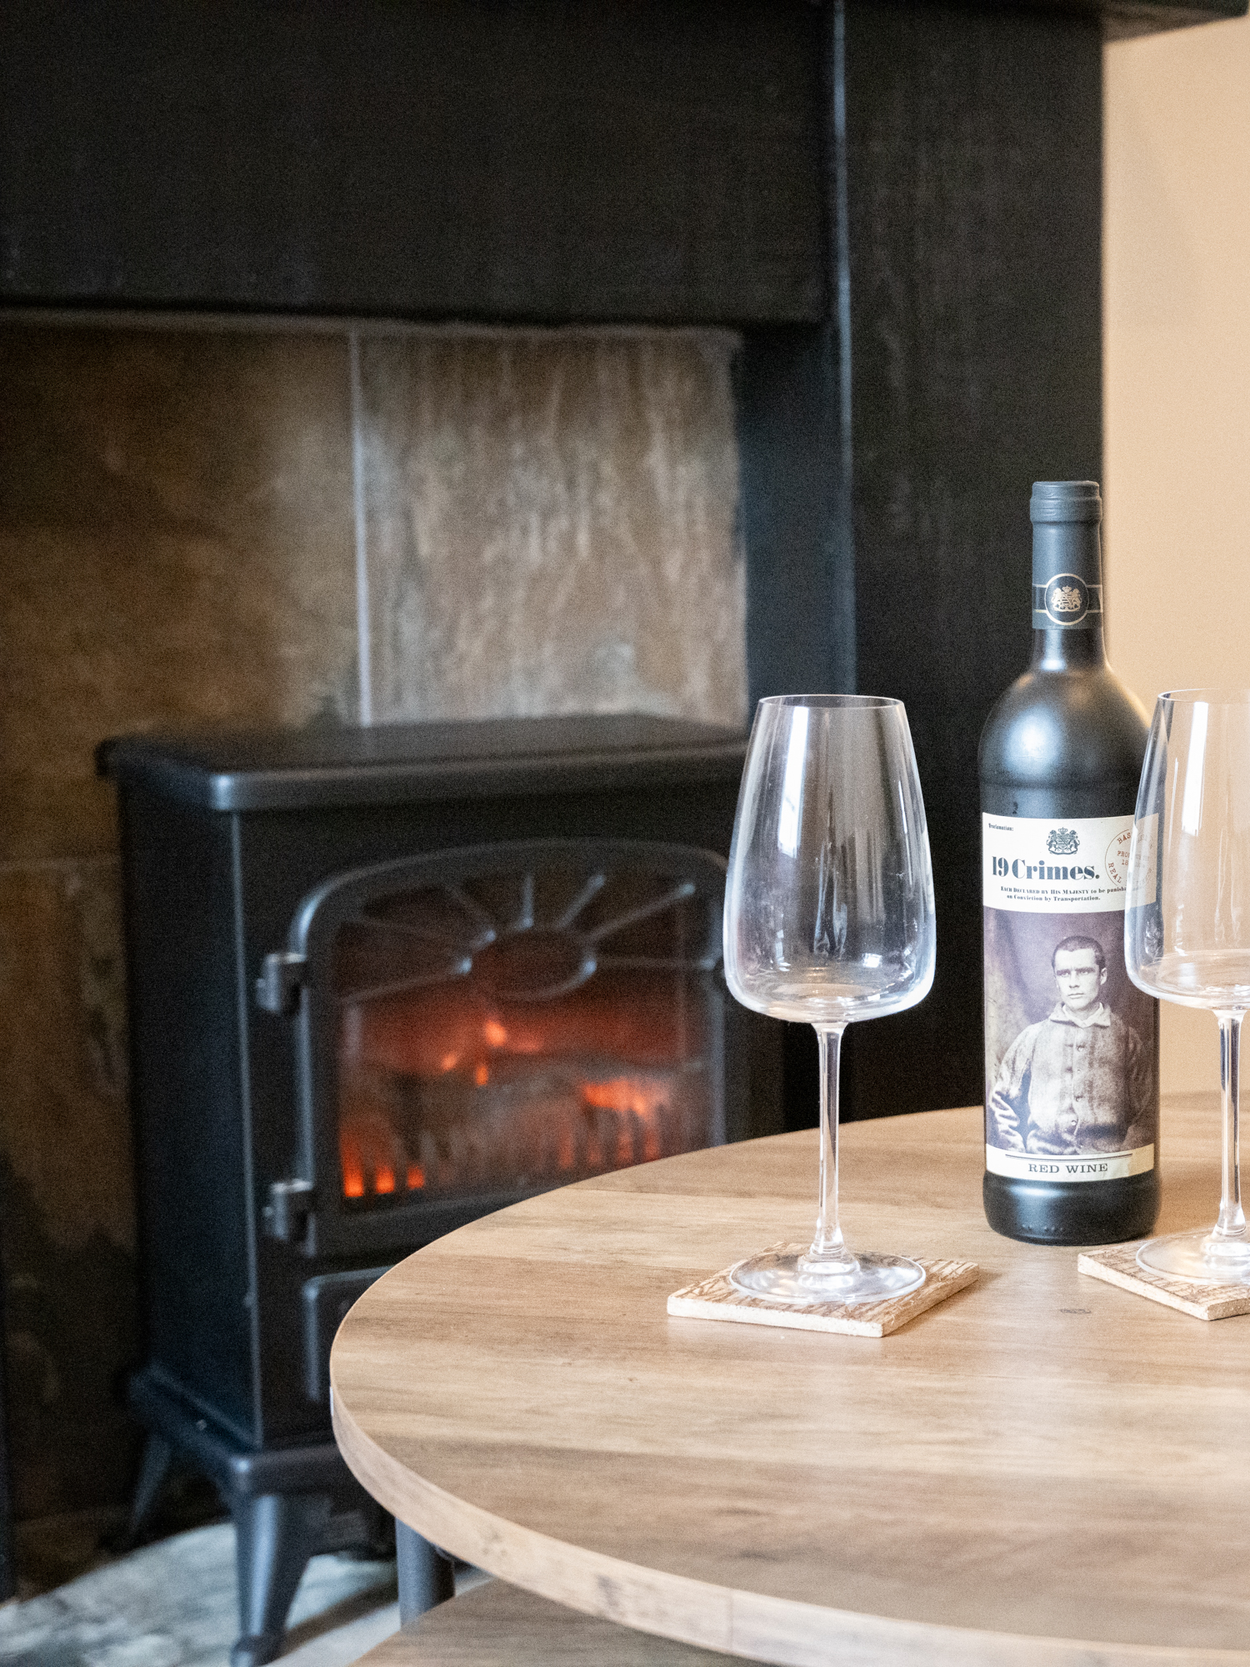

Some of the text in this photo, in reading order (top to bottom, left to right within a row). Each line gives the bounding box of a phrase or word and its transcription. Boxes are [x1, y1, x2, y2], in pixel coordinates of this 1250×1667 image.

[992, 856, 1100, 880] 19 Crimes.
[1028, 1163, 1109, 1174] RED WINE
